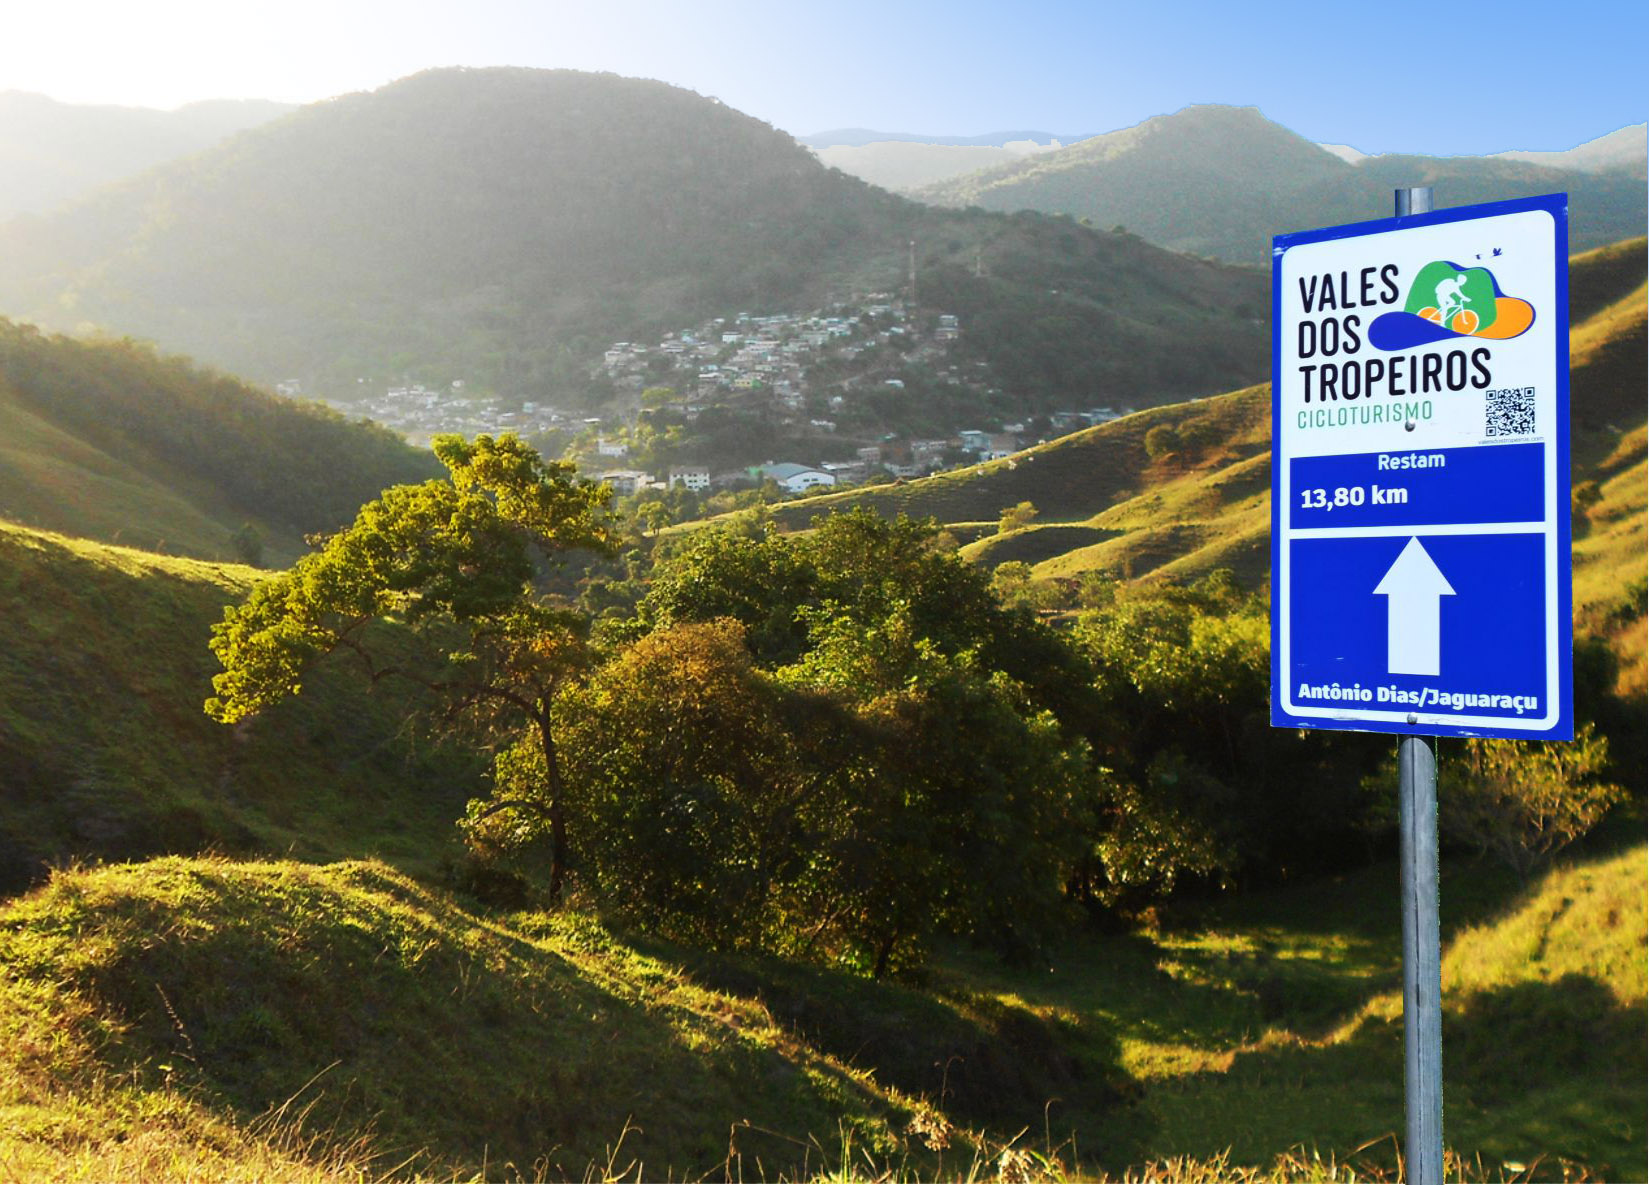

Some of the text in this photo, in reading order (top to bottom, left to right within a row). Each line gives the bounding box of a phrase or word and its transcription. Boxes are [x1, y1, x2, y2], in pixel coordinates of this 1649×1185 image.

[1298, 264, 1399, 313] VALES
[1298, 315, 1361, 359] DOS
[1298, 348, 1492, 403] TROPEIROS
[1297, 400, 1433, 429] CICLOTURISMO
[1378, 453, 1446, 471] Restam
[1300, 485, 1408, 511] 13,80 km
[1298, 683, 1372, 702] Antônio
